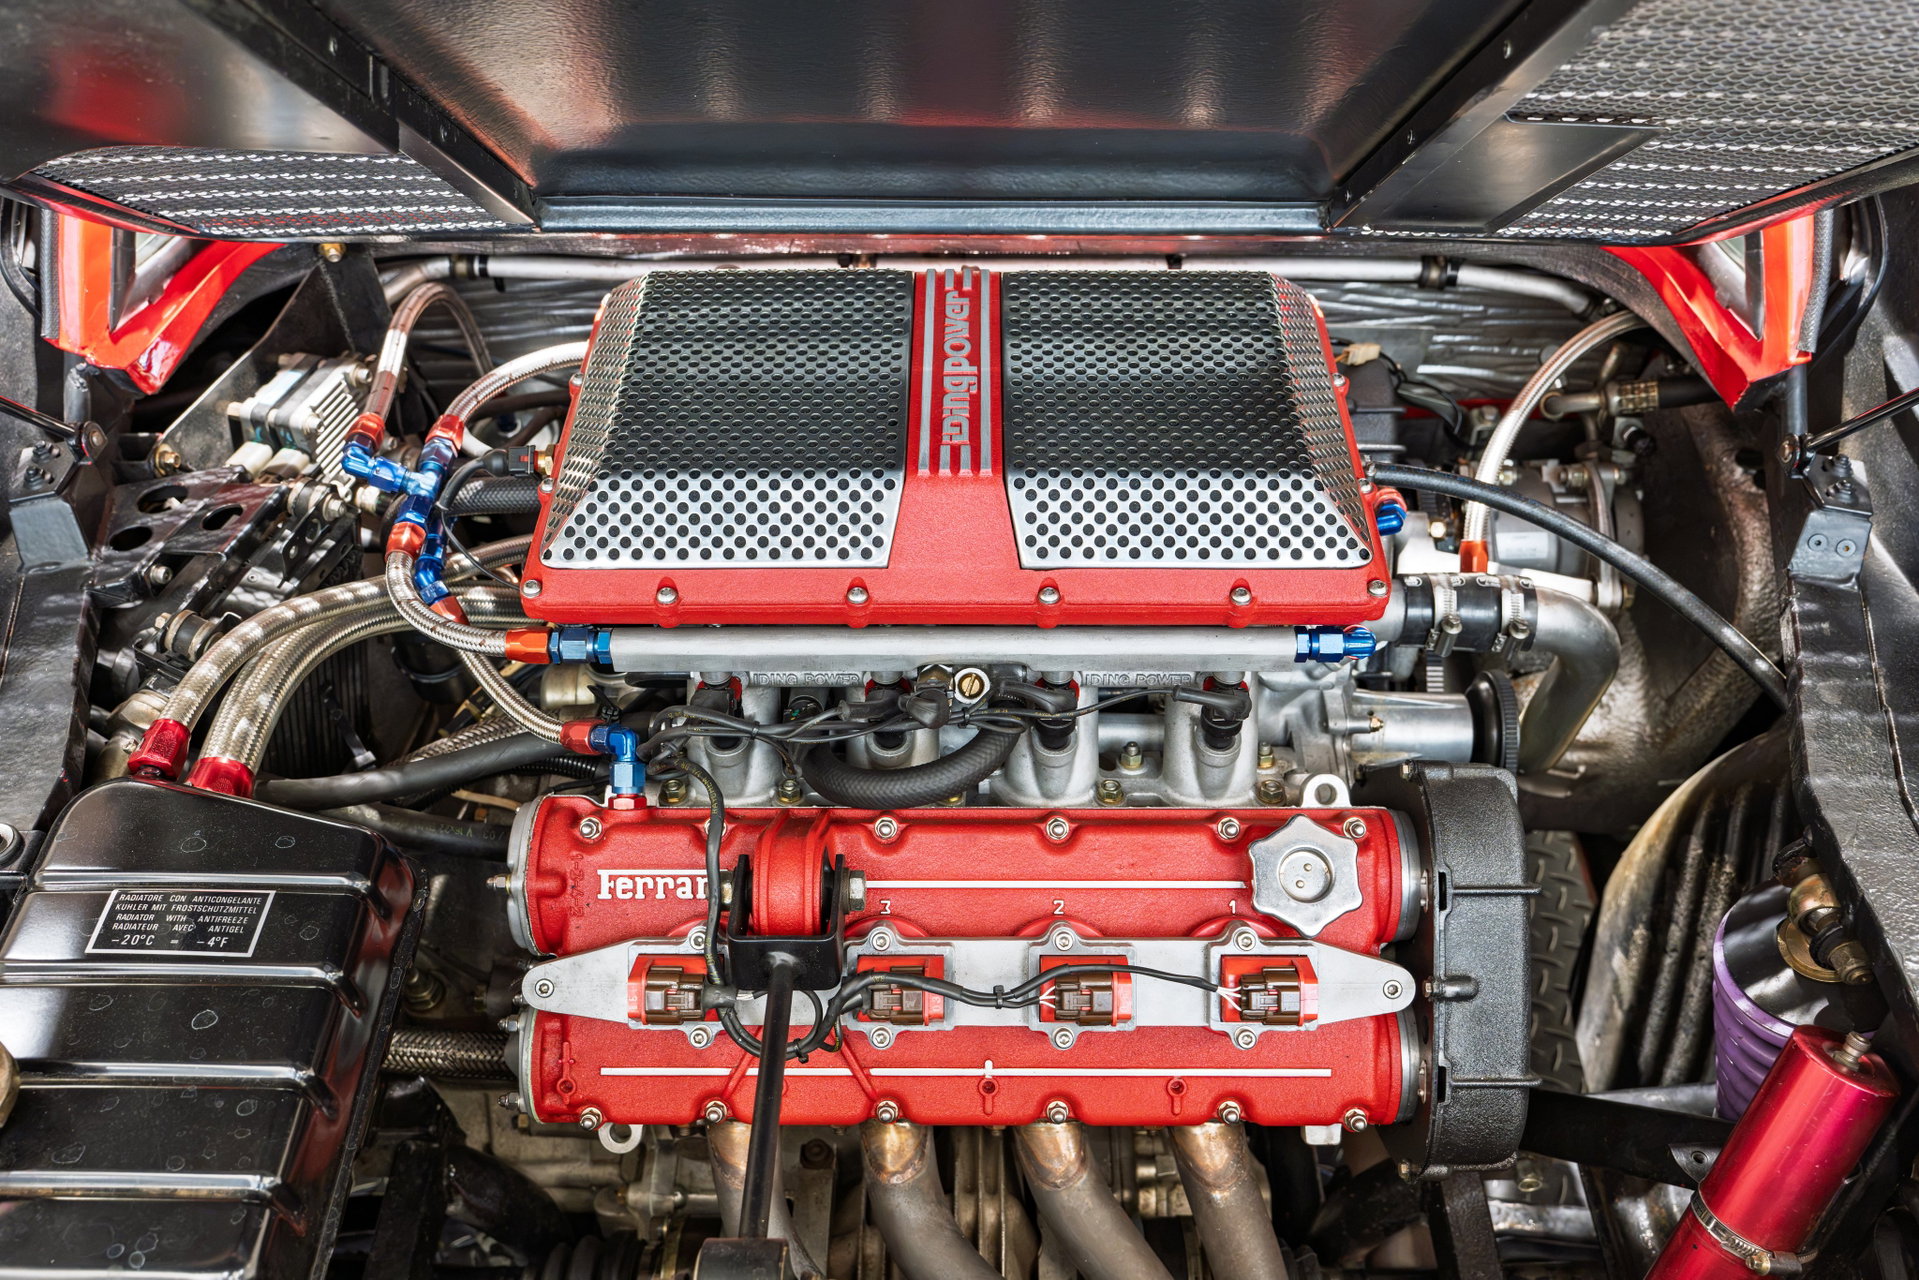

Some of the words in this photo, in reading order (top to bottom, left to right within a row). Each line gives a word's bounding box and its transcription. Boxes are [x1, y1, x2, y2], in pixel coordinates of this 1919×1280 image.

[804, 673, 860, 686] POWER
[1135, 673, 1192, 686] POWER
[597, 869, 709, 900] Ferrar
[119, 894, 165, 903] RADIATORE
[169, 895, 187, 903] CON
[192, 895, 263, 905] ANTICONGELANTE
[151, 904, 167, 912] MIT
[170, 905, 258, 915] FROSTSCHUTZMITTEL
[880, 900, 891, 914] 3
[1053, 900, 1065, 914] 2
[1229, 900, 1237, 914] 1
[115, 913, 155, 922] RADIATOR
[166, 914, 187, 922] WITH
[197, 915, 249, 924] ANTIFREEZE
[112, 922, 159, 931] RADIATEUR
[172, 924, 194, 932] AVEC
[207, 925, 245, 934] ANTIGEL
